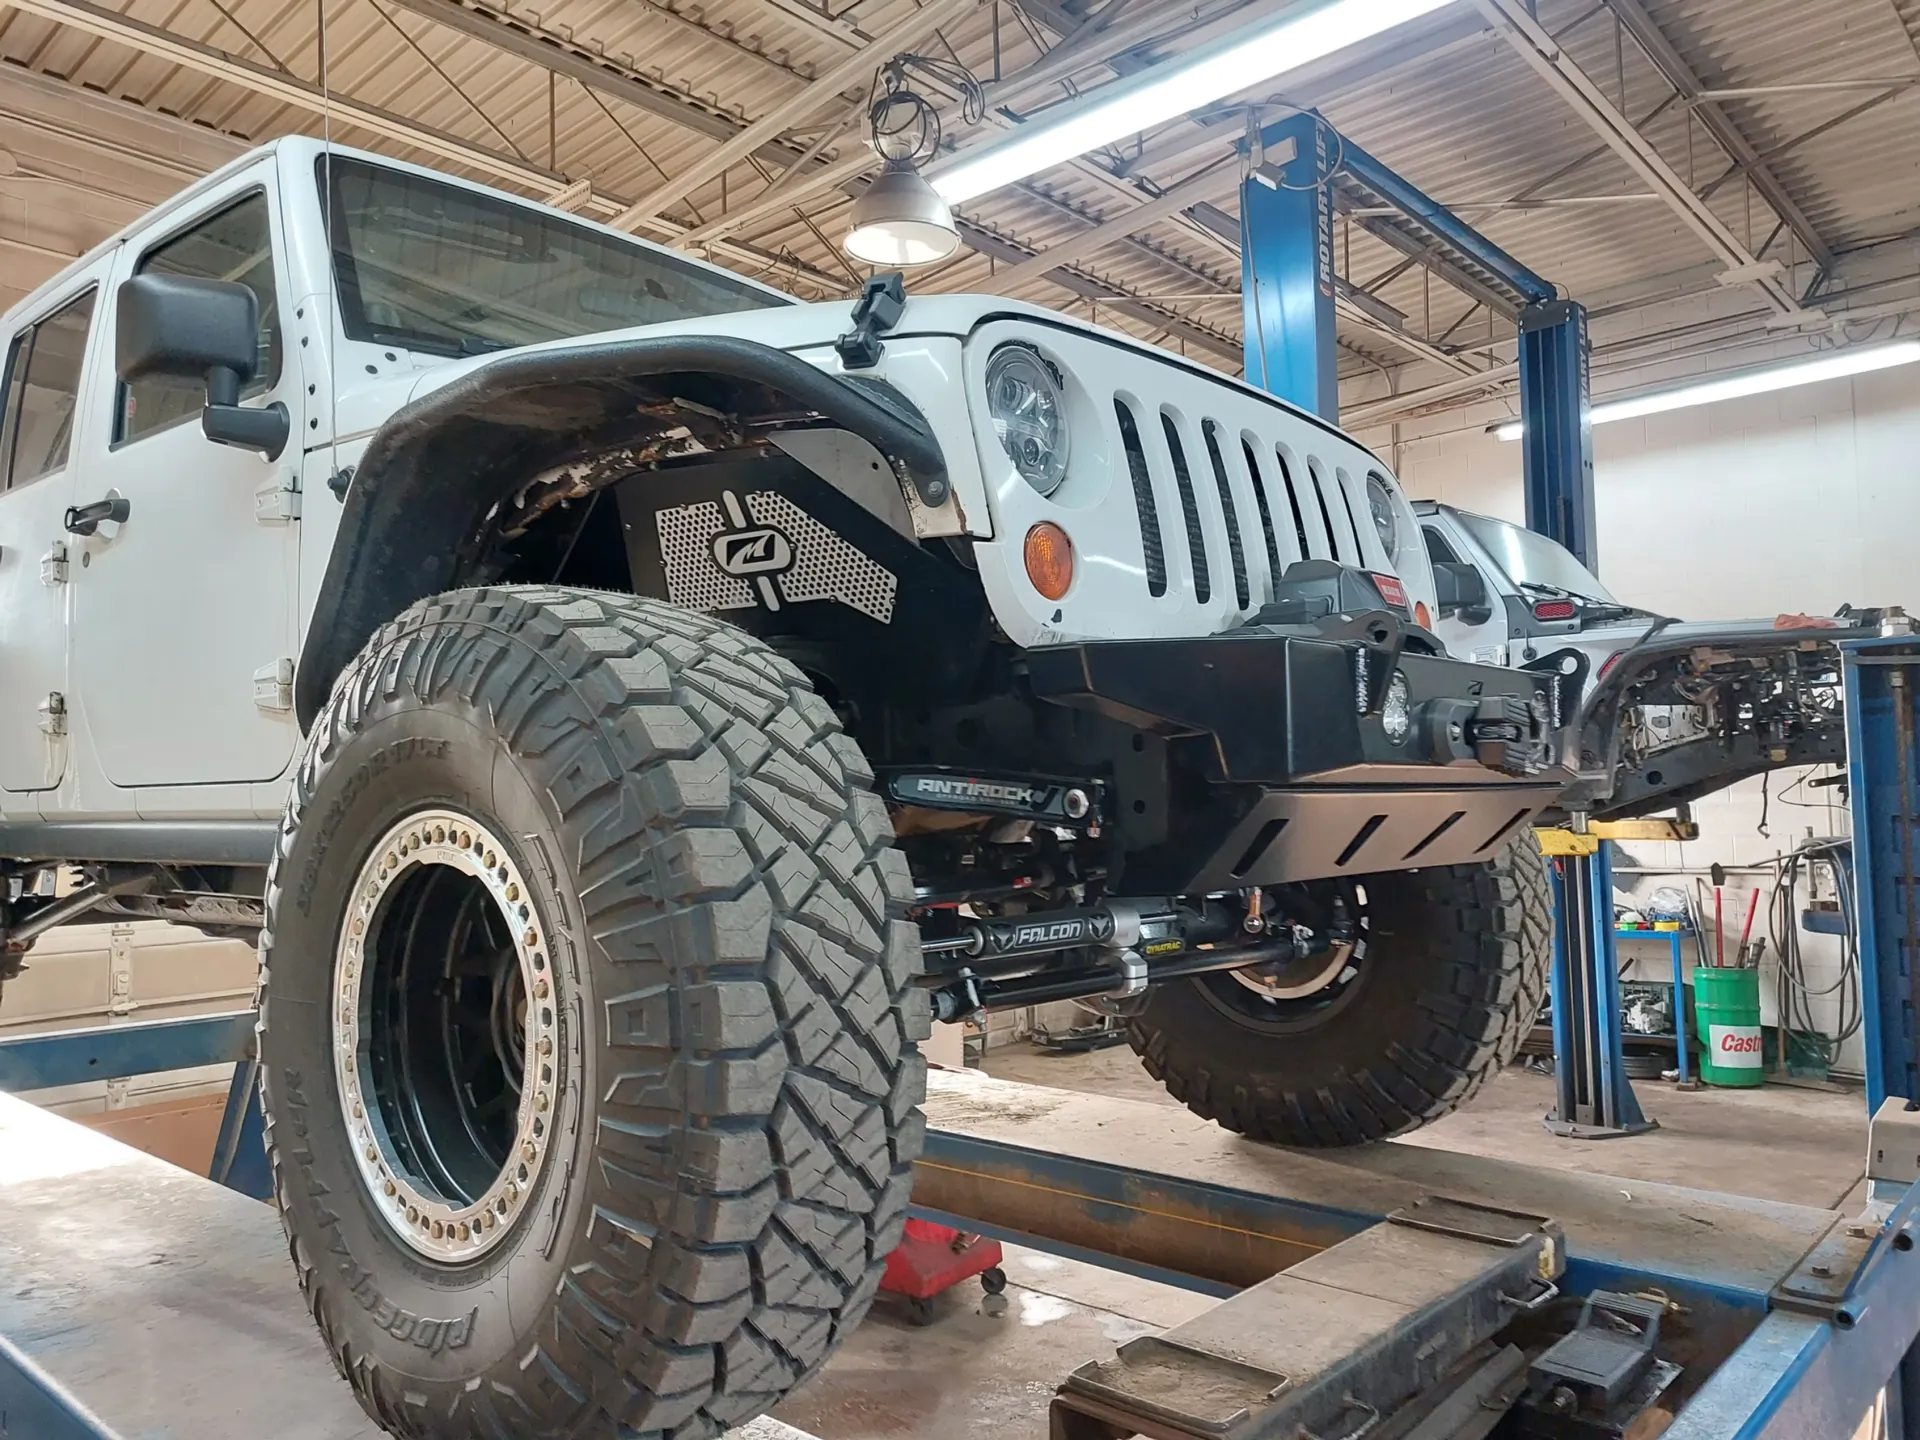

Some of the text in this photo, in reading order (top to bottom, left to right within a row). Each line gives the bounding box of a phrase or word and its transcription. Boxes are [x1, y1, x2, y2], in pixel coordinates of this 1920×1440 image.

[1315, 118, 1331, 284] ROTARY LIFT
[1018, 922, 1081, 944] FALCON
[1146, 941, 1182, 954] DYNATRAC
